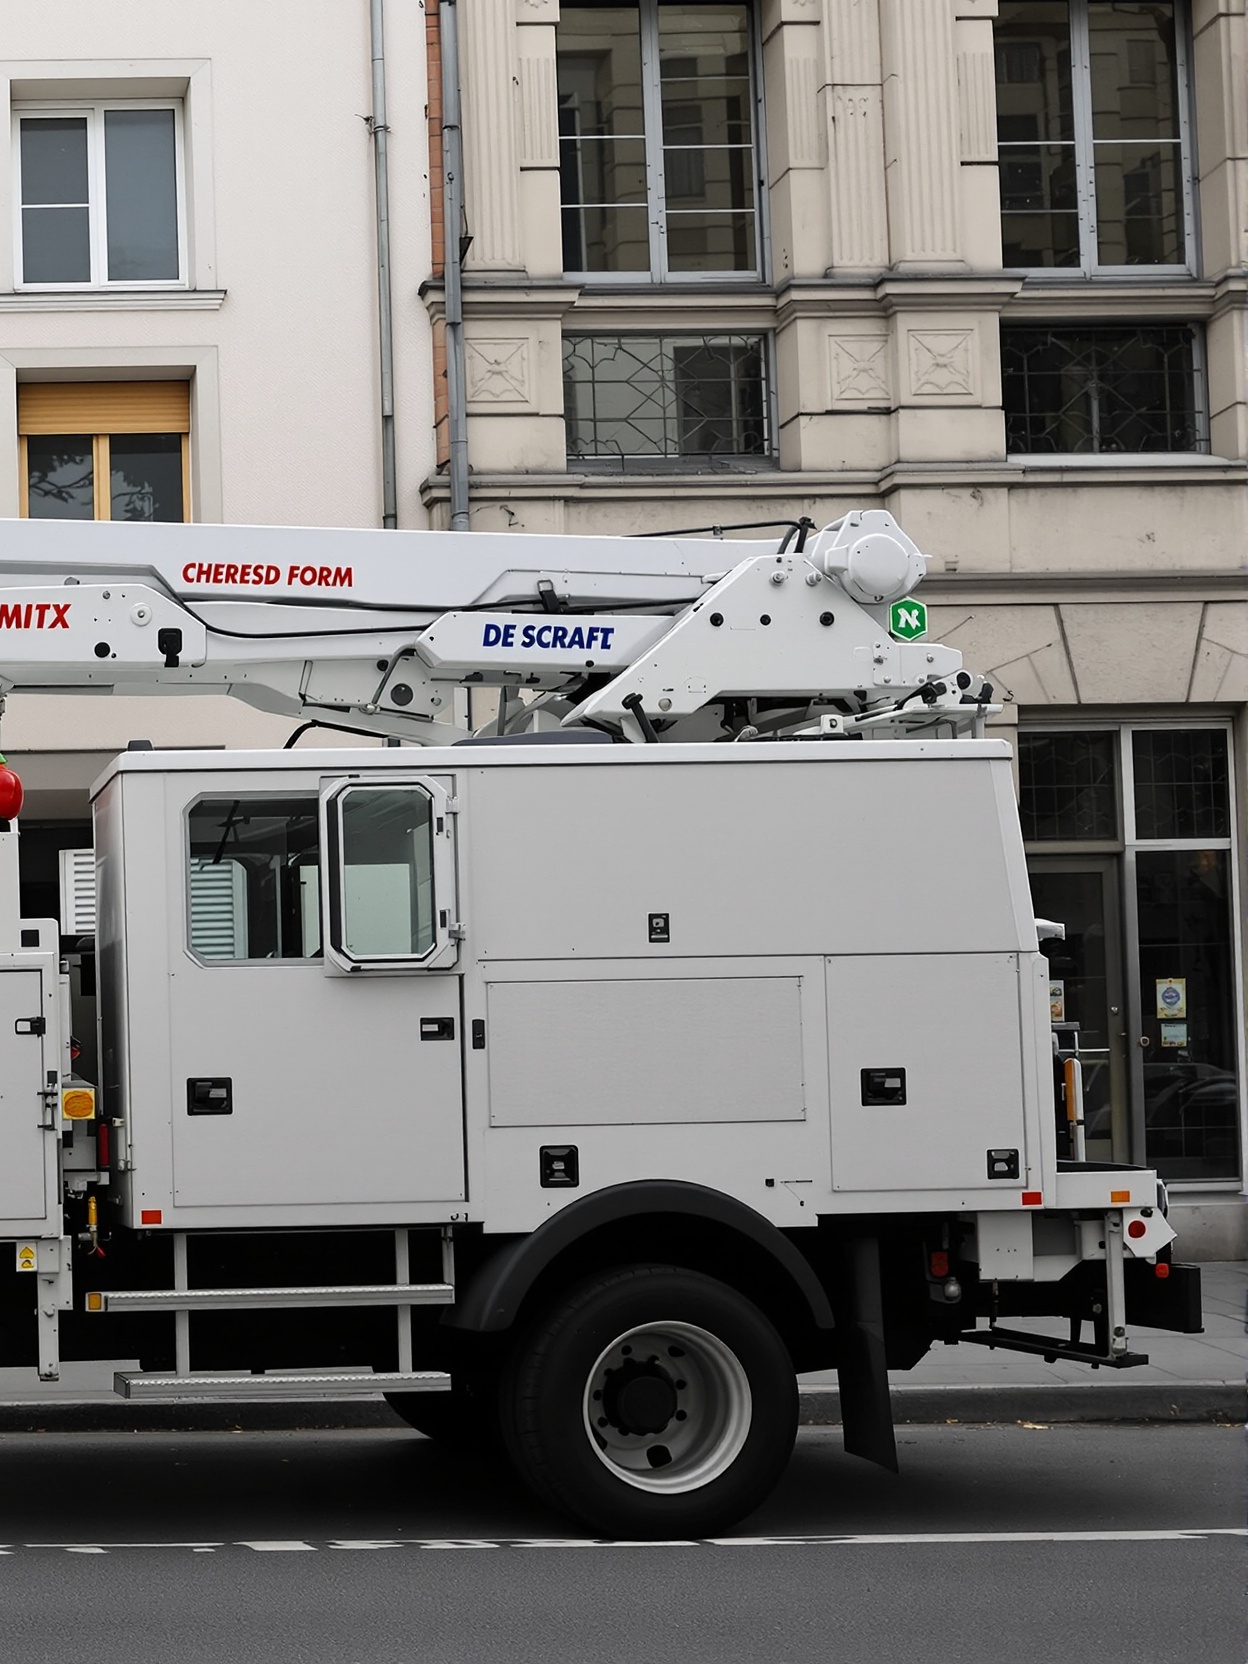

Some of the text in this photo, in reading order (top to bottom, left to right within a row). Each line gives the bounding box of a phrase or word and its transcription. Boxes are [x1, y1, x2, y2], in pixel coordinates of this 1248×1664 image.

[182, 562, 353, 587] CHERESD FORM
[482, 623, 615, 650] DE SCRAFT
